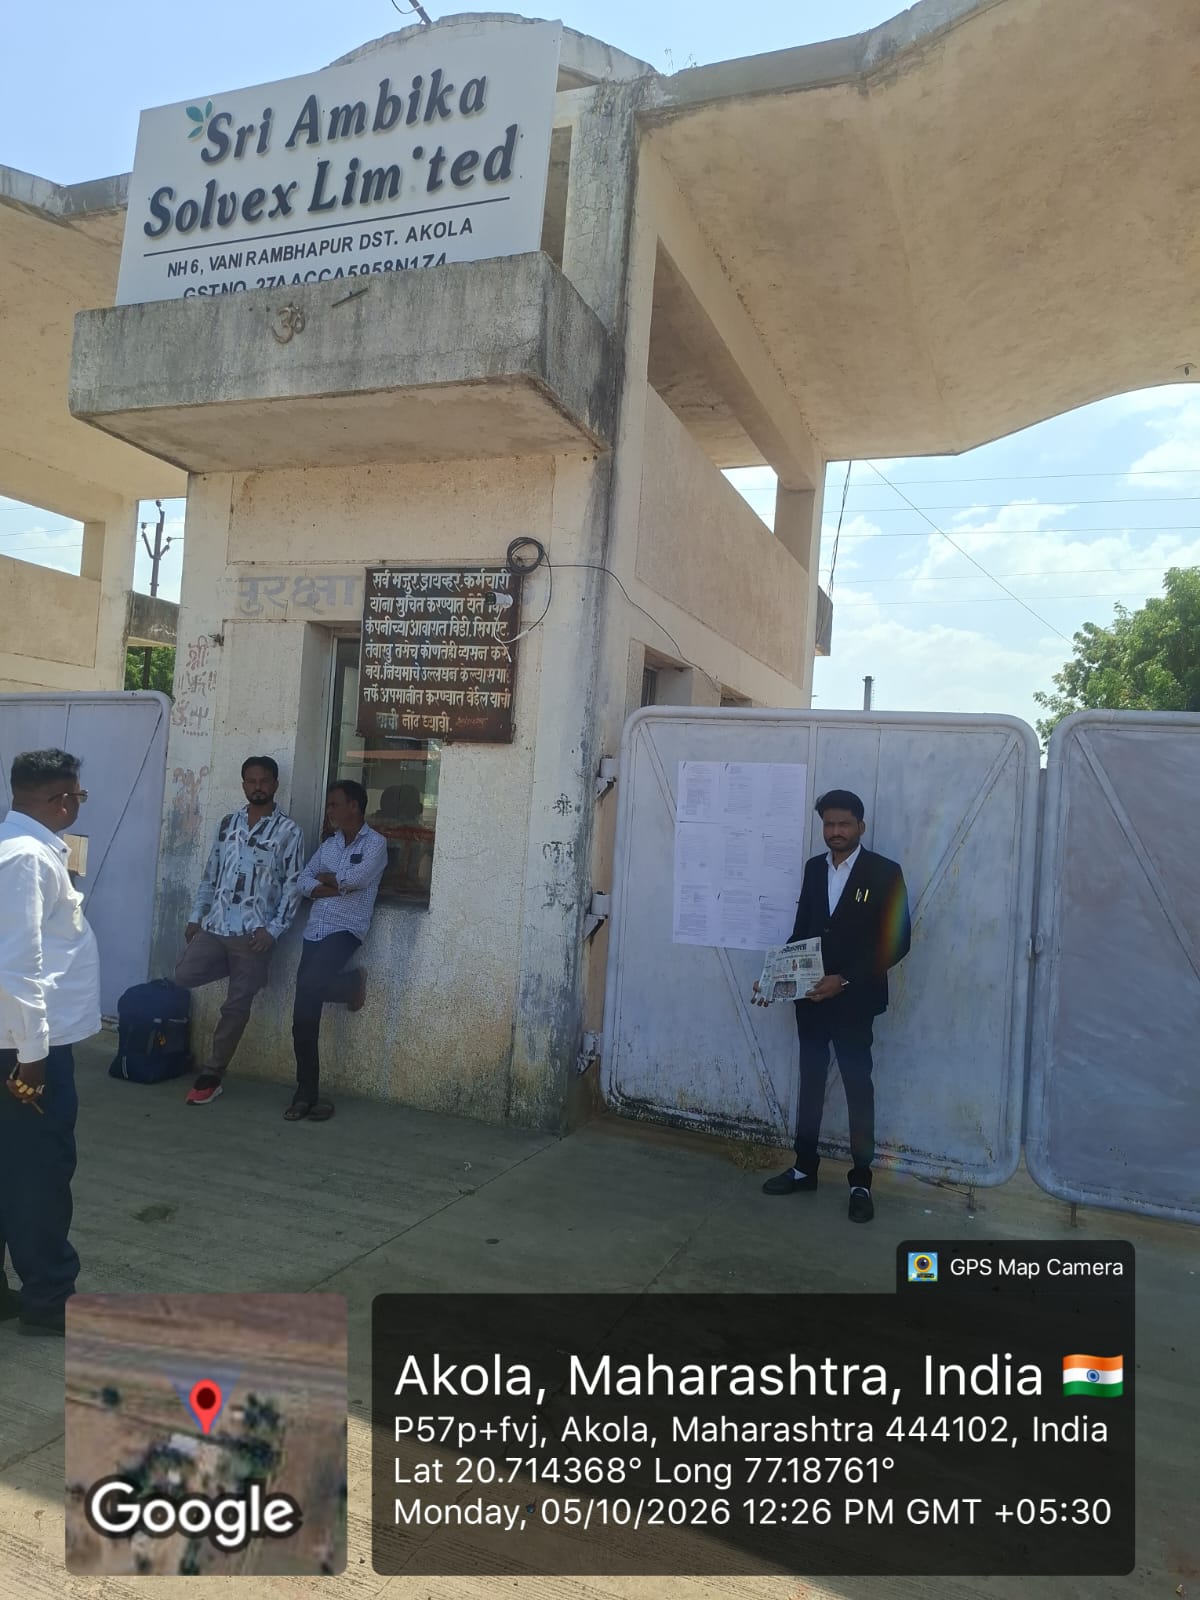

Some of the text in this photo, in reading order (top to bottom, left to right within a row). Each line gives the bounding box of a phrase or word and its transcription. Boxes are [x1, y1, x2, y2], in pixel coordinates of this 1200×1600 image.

[200, 67, 487, 163] Sri Ambika
[143, 123, 519, 238] Solvex Limted
[359, 230, 398, 250] DST.
[405, 217, 473, 244] AKOLA
[372, 568, 391, 590] सर्व
[463, 568, 512, 590] कर्मचारी
[369, 592, 394, 613] यांना
[395, 594, 426, 617] सुचित
[426, 596, 465, 614] करण्यात
[467, 593, 486, 614] येते
[365, 615, 409, 637] कंपनीच्या
[395, 639, 420, 660] तसेच
[420, 640, 458, 662] कोणतेही
[458, 645, 490, 662] व्यसन
[383, 661, 421, 682] नियमाचे
[425, 689, 465, 706] करण्यात
